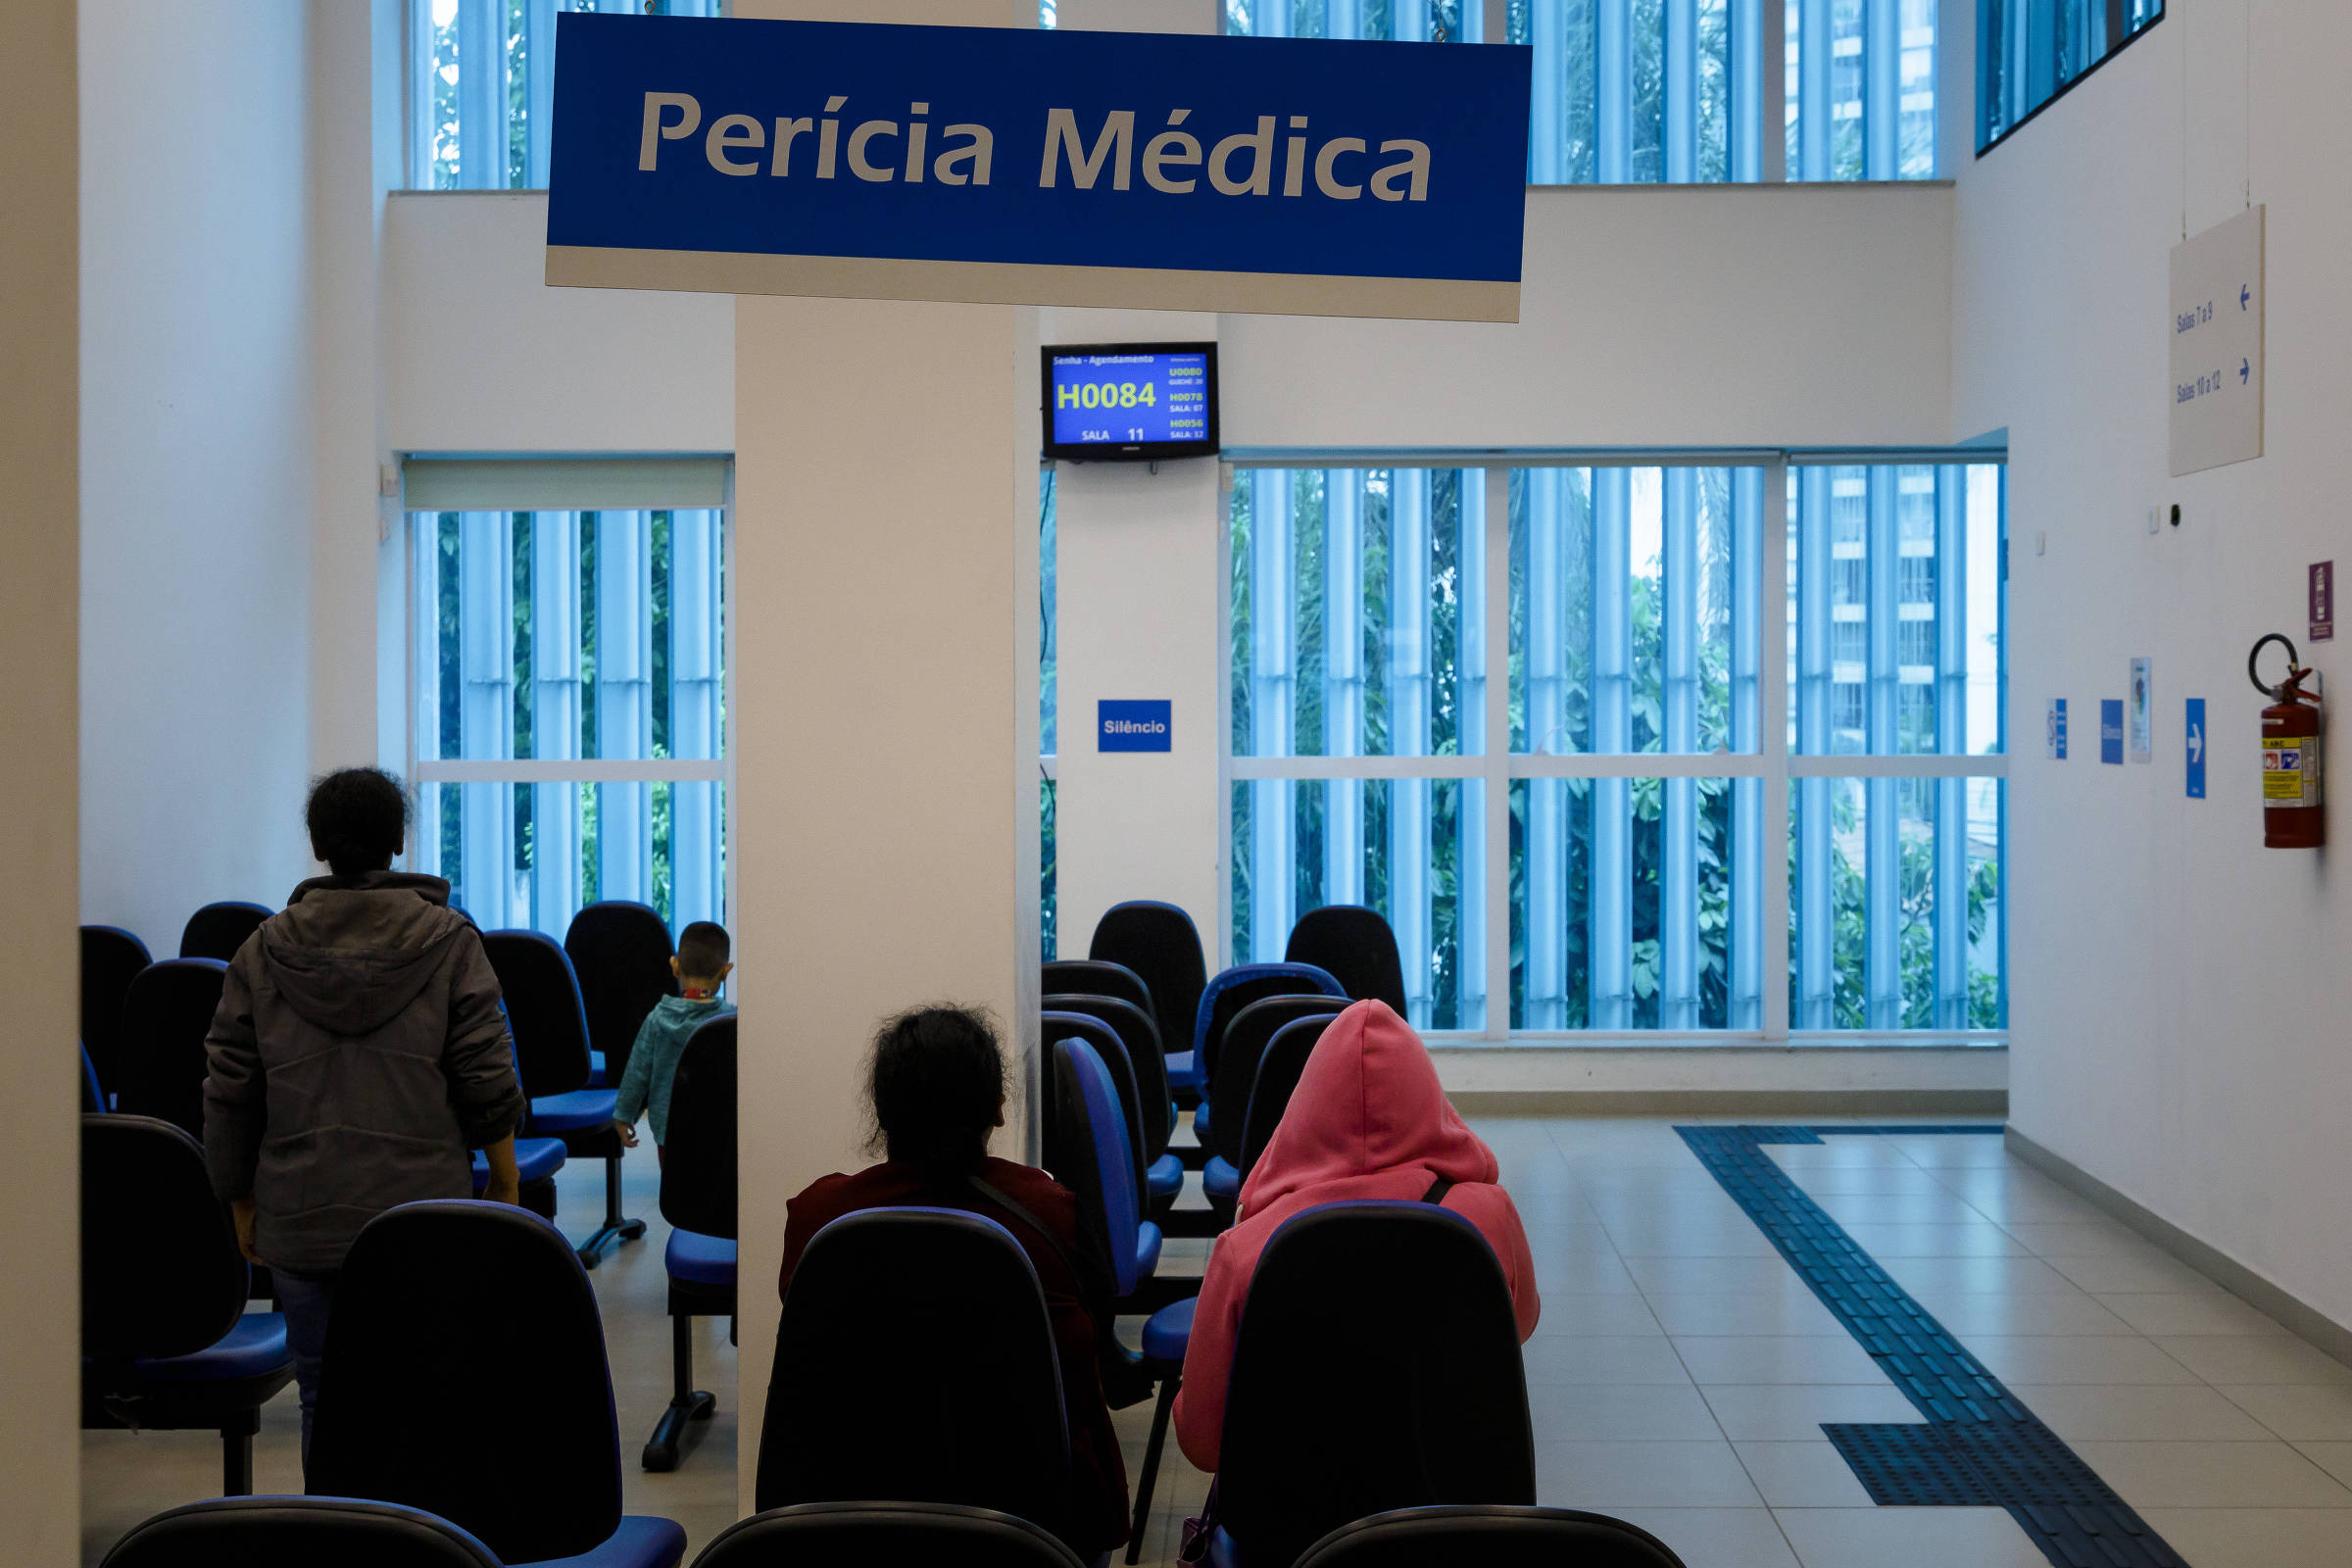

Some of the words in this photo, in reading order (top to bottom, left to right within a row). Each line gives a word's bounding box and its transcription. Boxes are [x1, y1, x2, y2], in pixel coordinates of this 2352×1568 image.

[638, 91, 994, 186] Perícia
[1039, 108, 1431, 202] Médica
[2178, 313, 2195, 333] Salas
[2196, 306, 2201, 325] 7
[2202, 308, 2207, 323] a
[2208, 301, 2213, 320] 9
[1054, 356, 1082, 366] Senha
[1089, 355, 1154, 367] Agendamento
[1057, 382, 1156, 409] H0084
[2178, 383, 2195, 404] Salas
[2196, 375, 2205, 396] 10
[2206, 378, 2211, 393] a
[2212, 369, 2221, 390] 12
[1082, 430, 1109, 441] SALA
[1128, 428, 1144, 441] 11
[1104, 719, 1165, 734] Silêncio
